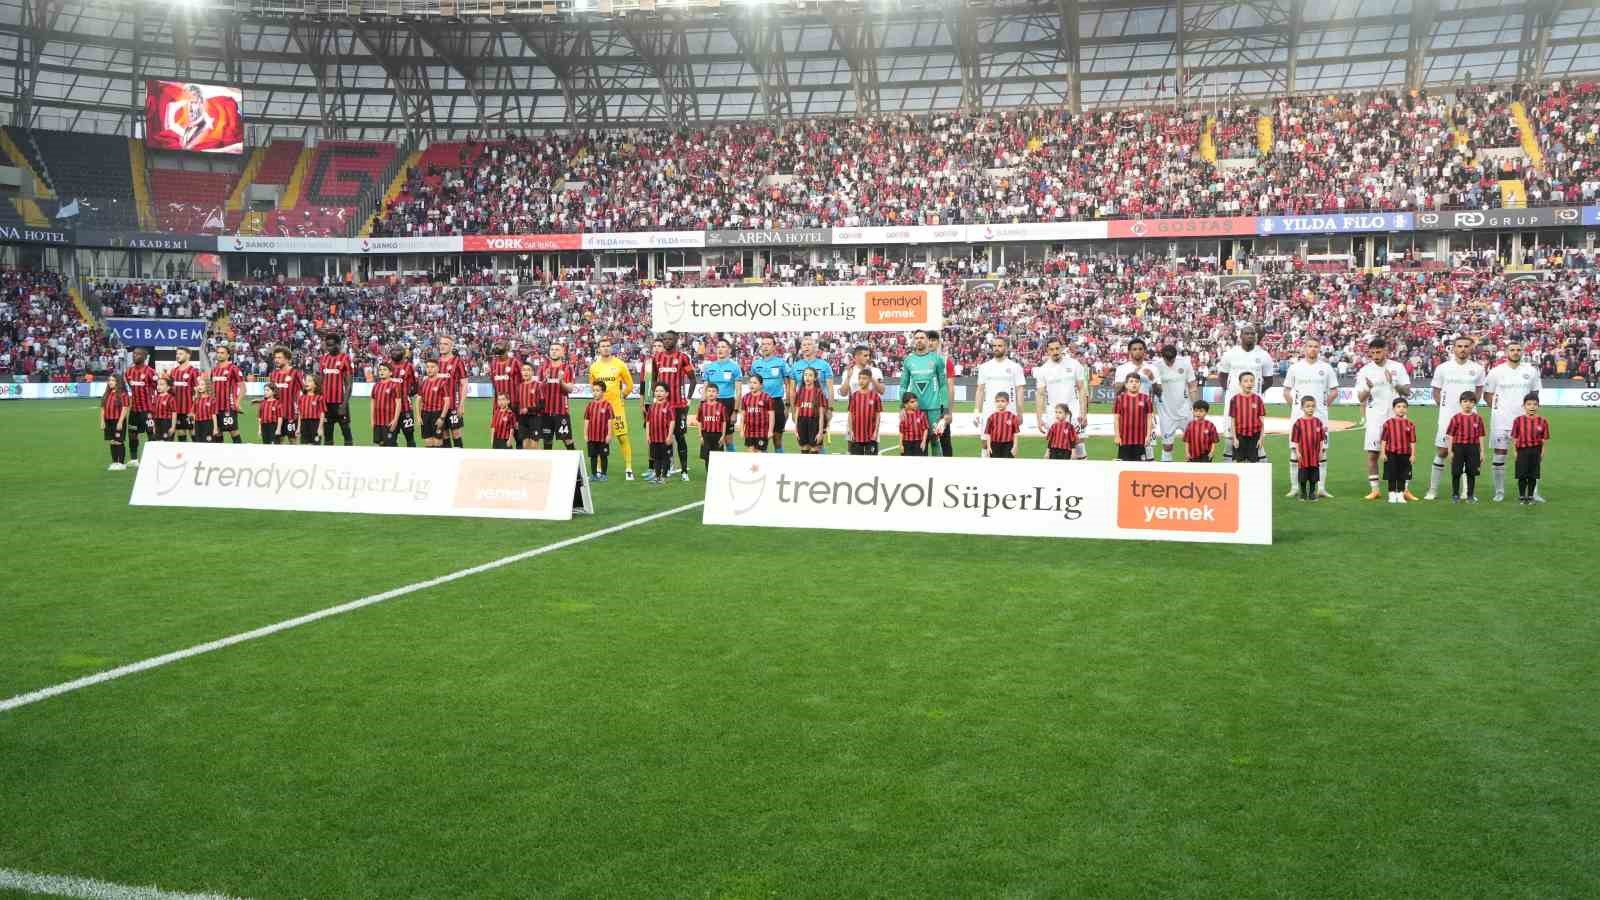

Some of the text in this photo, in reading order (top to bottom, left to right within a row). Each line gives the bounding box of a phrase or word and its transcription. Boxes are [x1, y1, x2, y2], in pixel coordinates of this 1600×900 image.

[1282, 217, 1337, 231] YILDA
[1490, 216, 1539, 226] GRUP
[24, 231, 65, 242] HOTEL
[738, 231, 782, 243] ARENA
[785, 232, 825, 243] HOTEL
[487, 239, 523, 249] YORK
[872, 296, 922, 307] trendyol
[691, 299, 857, 321] trendyol SüperLig
[879, 309, 915, 320] yemek
[110, 328, 203, 340] ACIBADEM
[223, 417, 234, 426] 50
[403, 418, 414, 428] 22
[558, 425, 569, 434] 44
[193, 461, 433, 501] trendyol SüperLig
[776, 474, 1083, 520] trendyol SüperLig
[1131, 480, 1228, 503] trendyol
[1144, 505, 1216, 522] yemek
